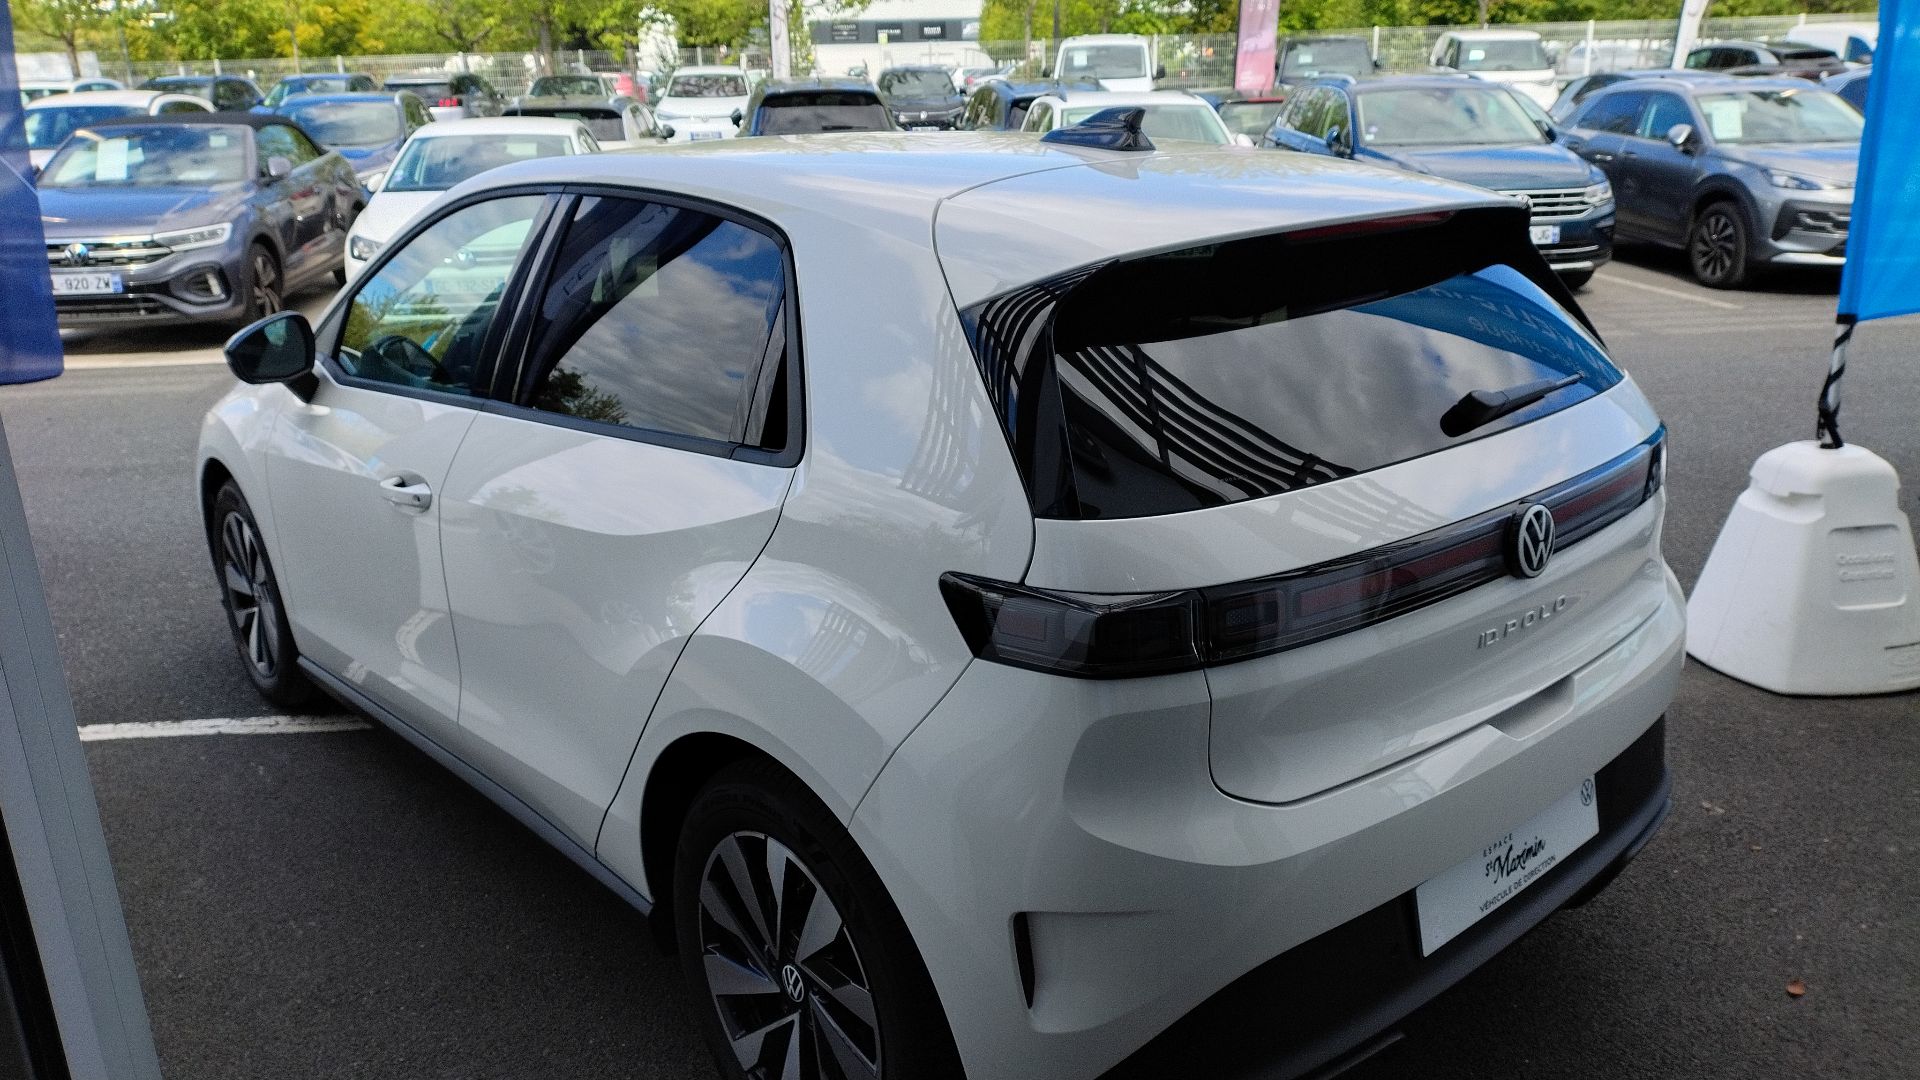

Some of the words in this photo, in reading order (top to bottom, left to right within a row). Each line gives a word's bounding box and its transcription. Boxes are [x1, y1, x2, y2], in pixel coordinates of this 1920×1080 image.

[1504, 594, 1566, 638] POLO
[1483, 833, 1513, 857] ESPACE
[1493, 836, 1547, 884] Maximin
[1513, 878, 1523, 890] DE
[1523, 855, 1556, 883] DIRECTION
